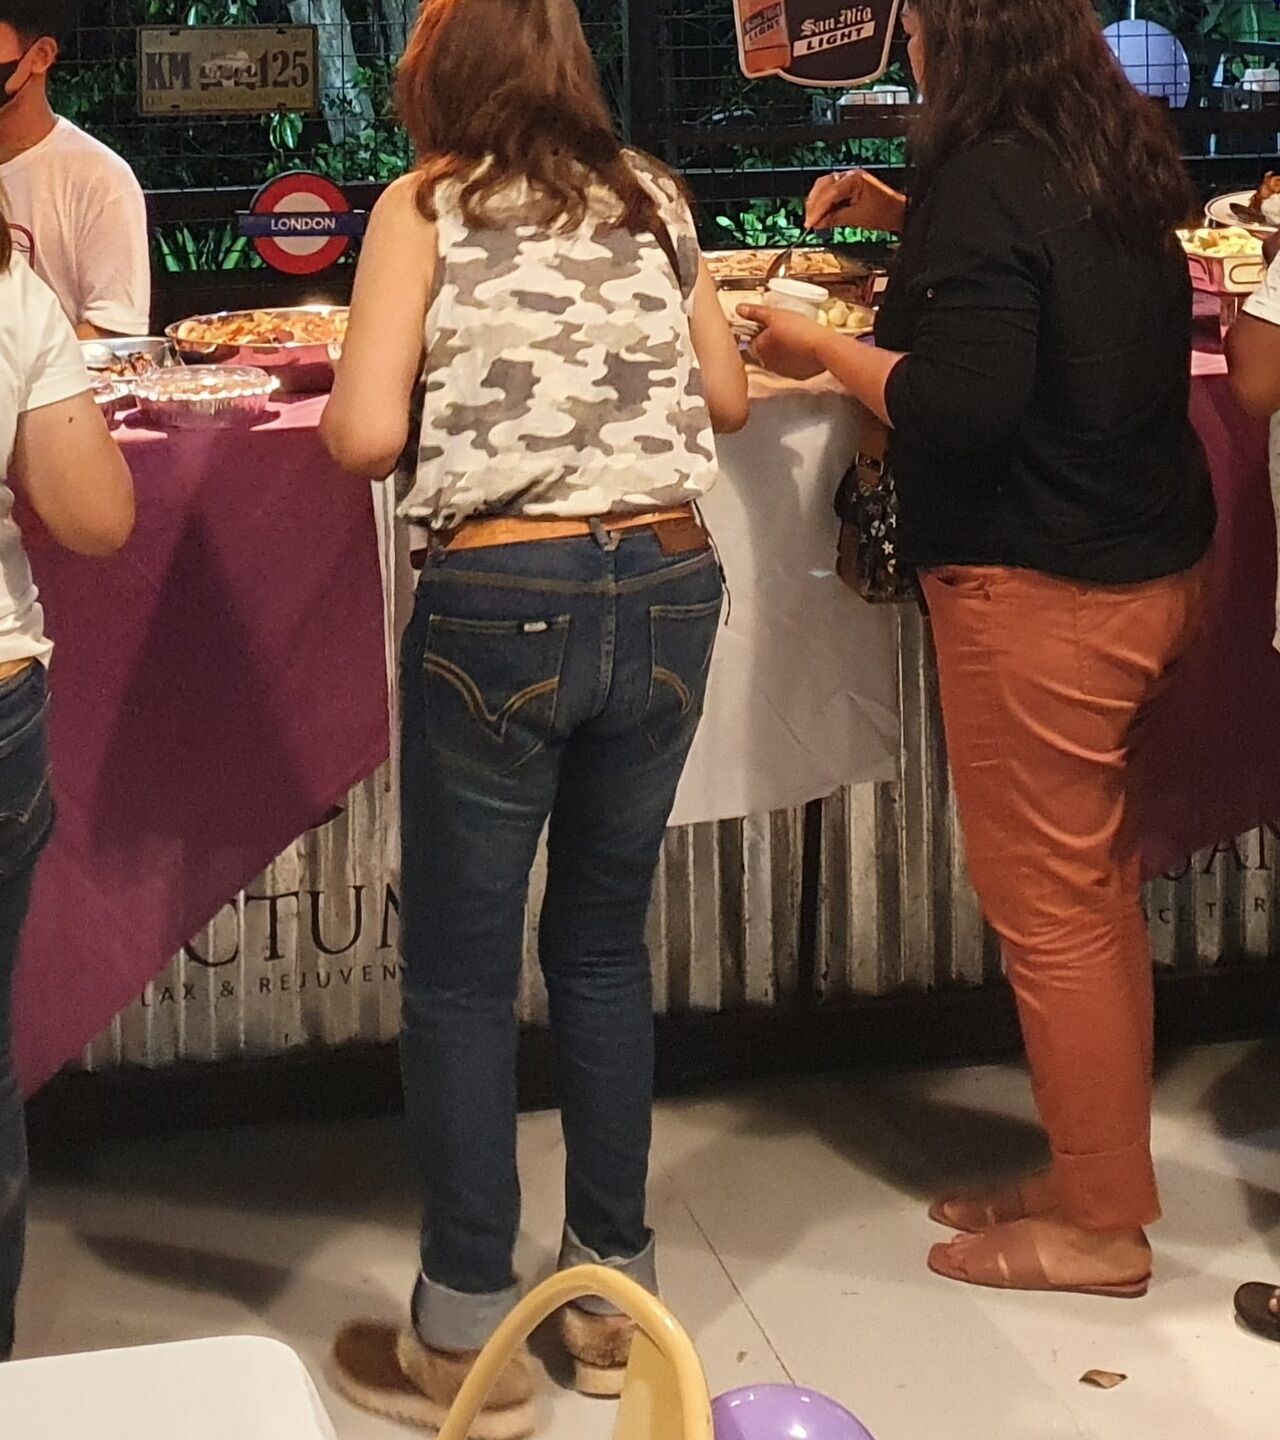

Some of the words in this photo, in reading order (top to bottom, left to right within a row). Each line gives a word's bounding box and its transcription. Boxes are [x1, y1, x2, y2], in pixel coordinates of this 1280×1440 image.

[800, 15, 835, 37] San
[837, 5, 872, 28] Mig
[806, 26, 865, 51] LIGHT
[145, 51, 192, 90] KM
[257, 50, 309, 89] 125
[271, 217, 336, 231] LONDON
[140, 982, 196, 1007] LAX
[220, 979, 235, 999] &
[259, 963, 404, 993] REJUVEN
